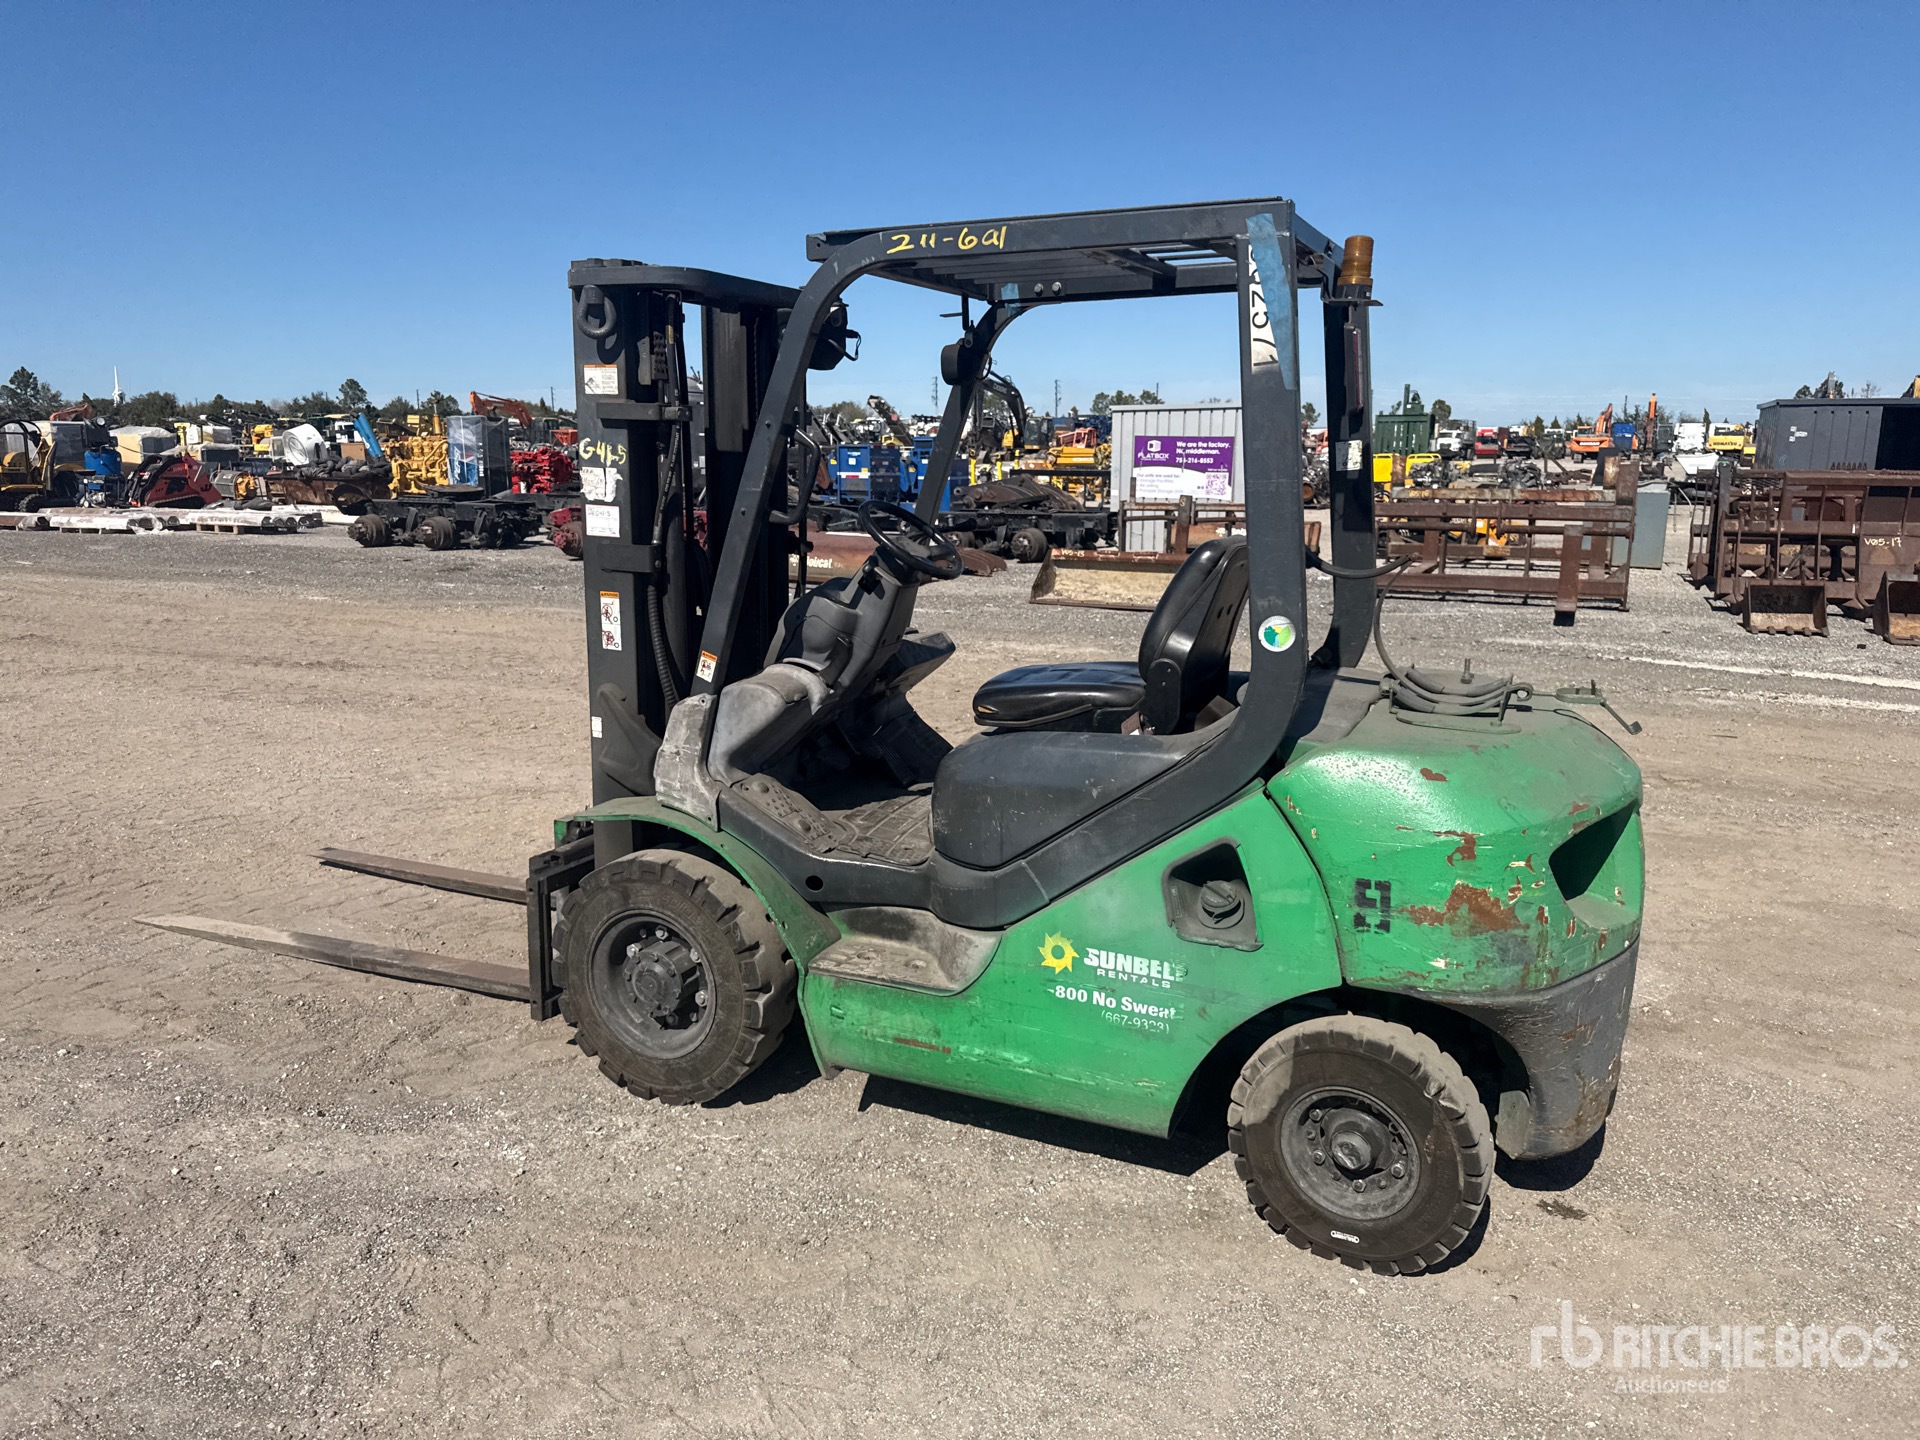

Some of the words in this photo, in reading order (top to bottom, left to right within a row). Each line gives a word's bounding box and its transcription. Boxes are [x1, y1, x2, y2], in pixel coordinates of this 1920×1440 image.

[1208, 441, 1231, 449] factory.
[1084, 947, 1184, 982] SUNBEL
[1096, 968, 1171, 989] RENTALS
[1092, 991, 1117, 1009] No
[1120, 996, 1177, 1020] Sweat
